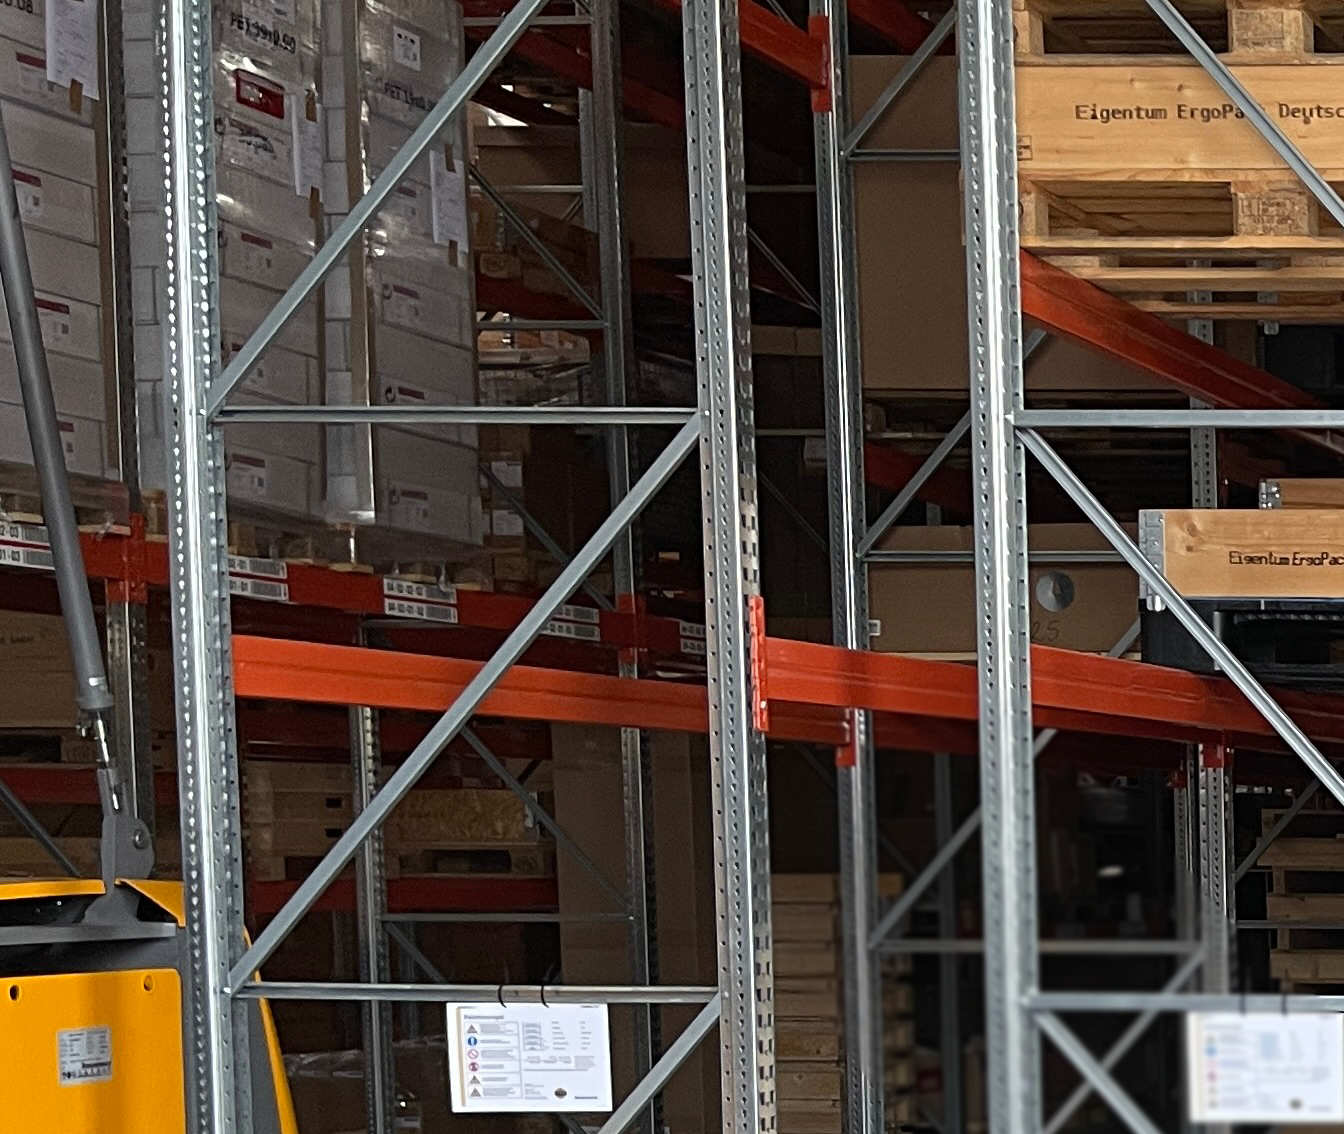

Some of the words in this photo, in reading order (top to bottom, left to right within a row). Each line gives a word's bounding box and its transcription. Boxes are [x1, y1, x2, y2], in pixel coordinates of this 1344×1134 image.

[1075, 103, 1167, 122] Eigentum
[1177, 103, 1264, 123] ErgoPa
[1229, 551, 1290, 566] Eigentum
